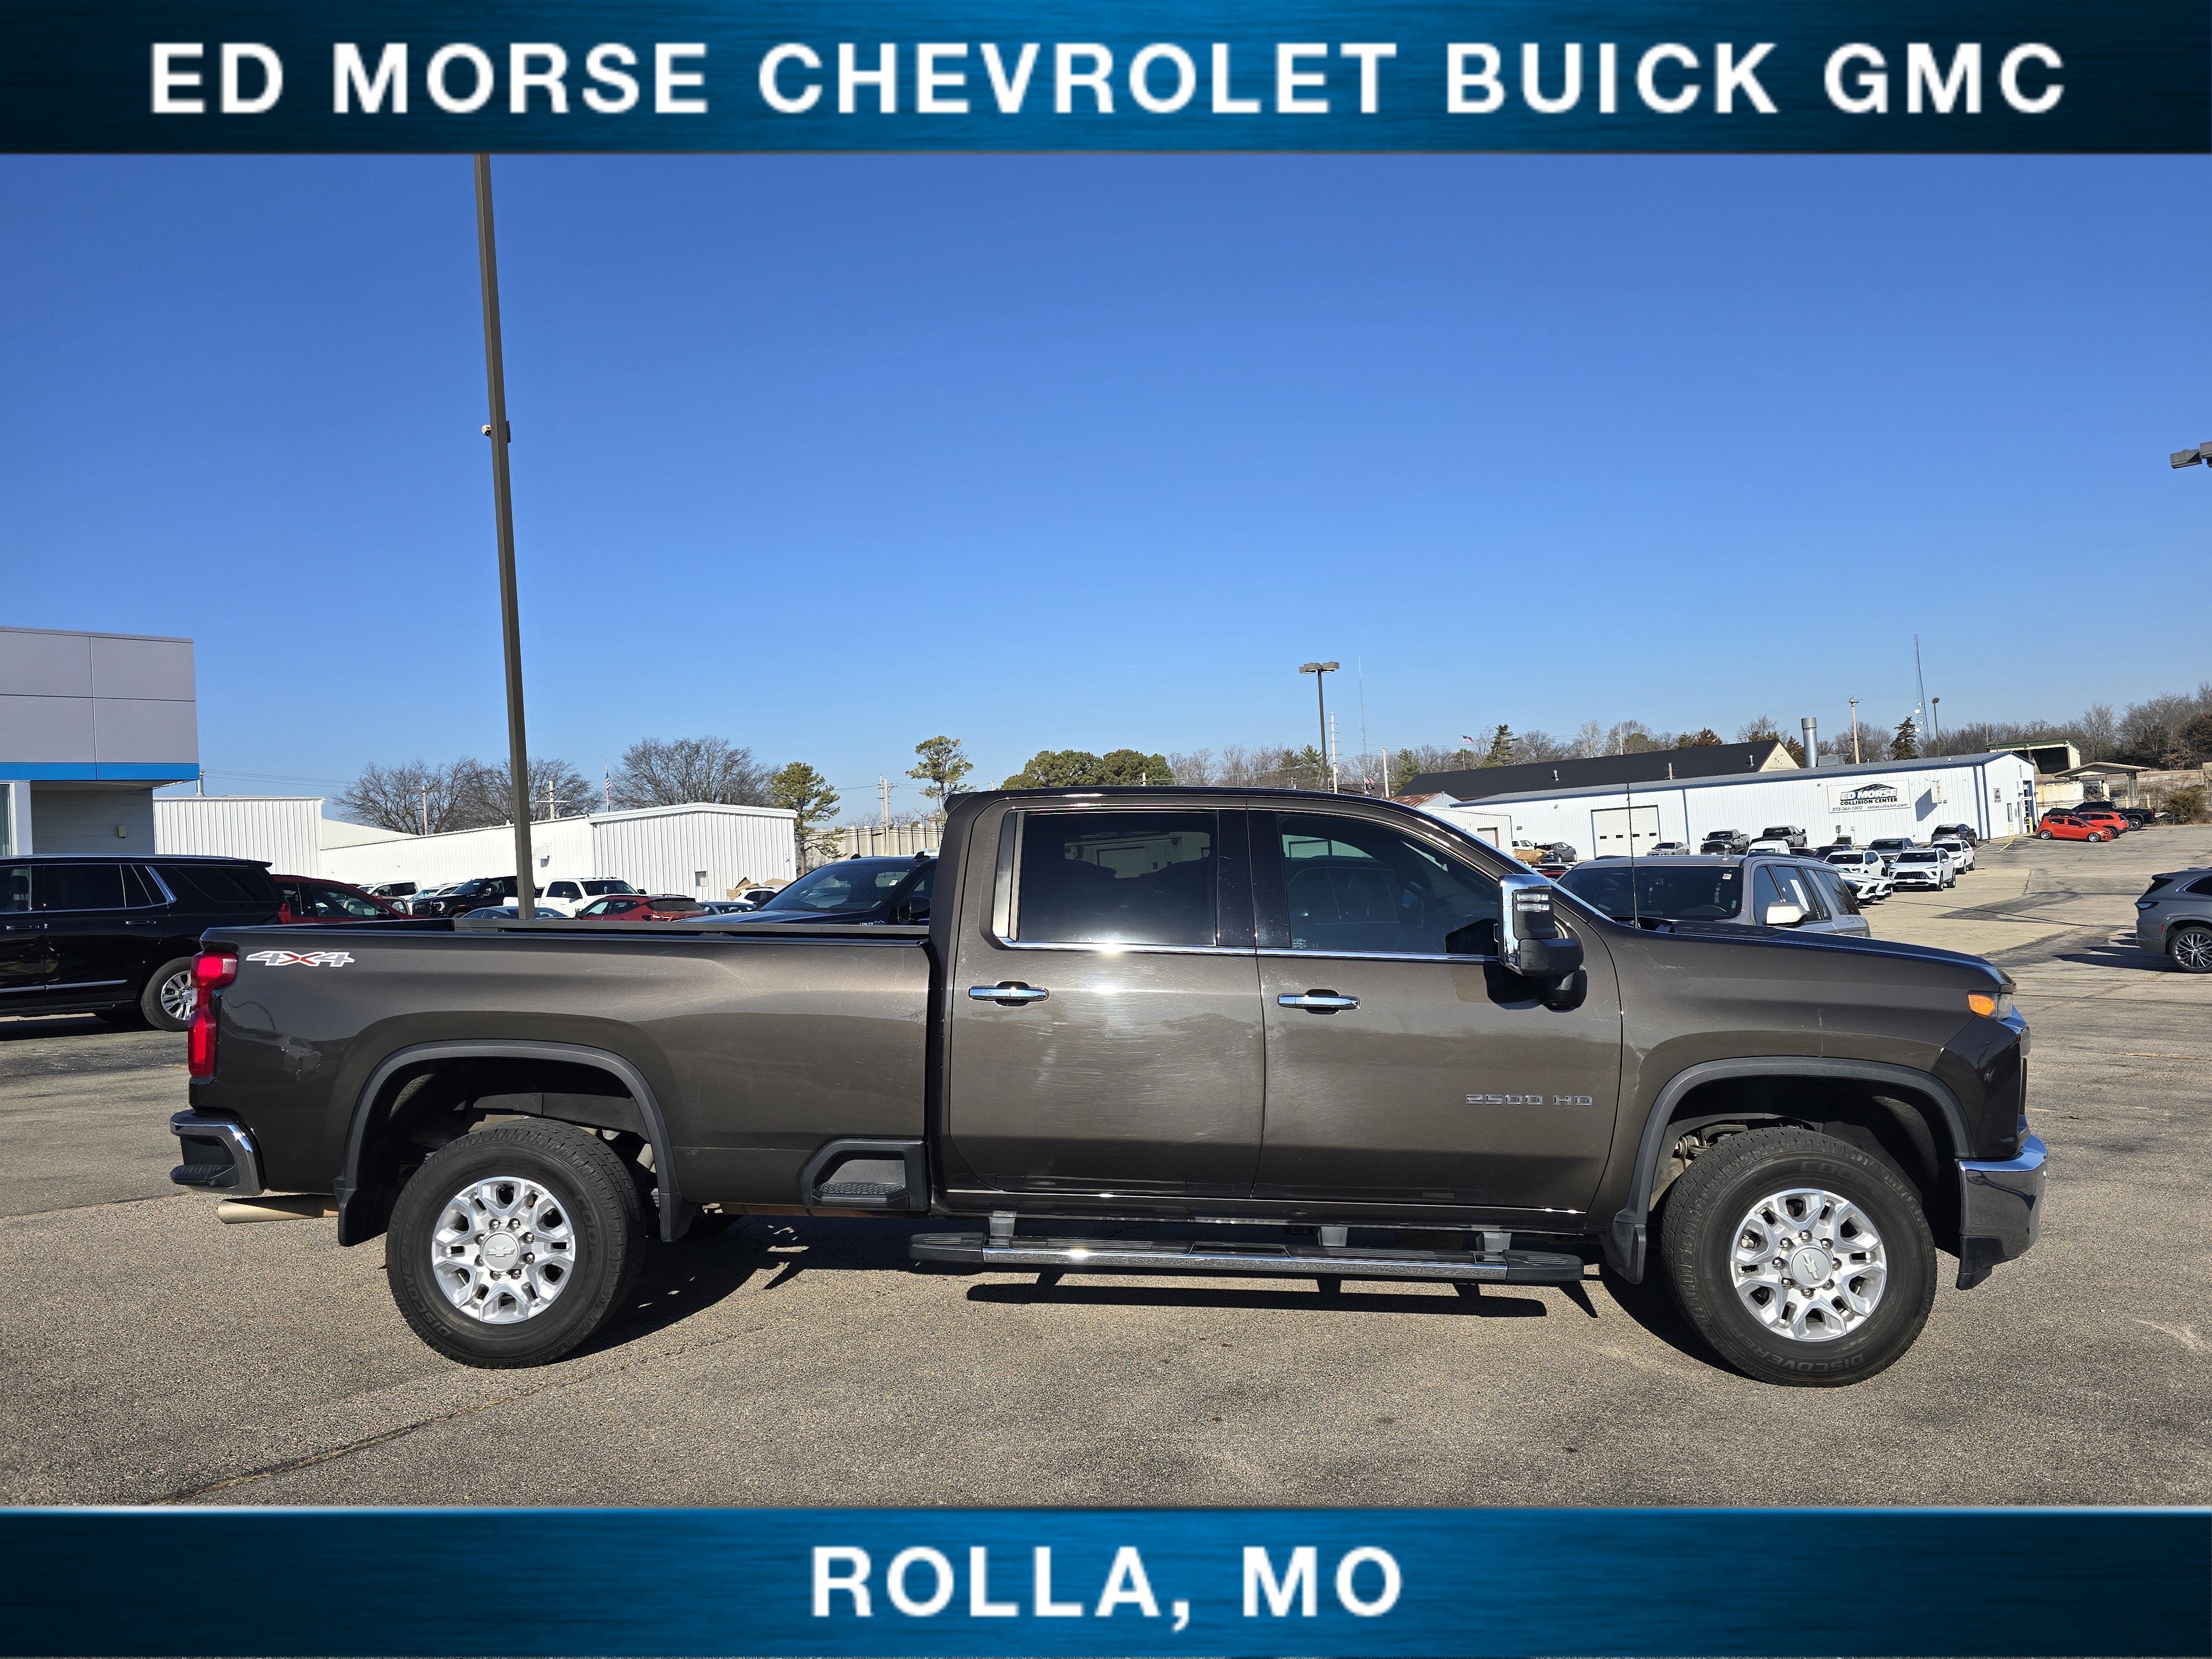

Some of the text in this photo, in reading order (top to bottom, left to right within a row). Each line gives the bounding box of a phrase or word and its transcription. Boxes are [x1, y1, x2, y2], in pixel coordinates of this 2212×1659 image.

[1840, 789, 1897, 801] ED MORSE
[1466, 1094, 1593, 1107] 2500 HD
[1729, 1317, 1865, 1373] DISCOVERER
